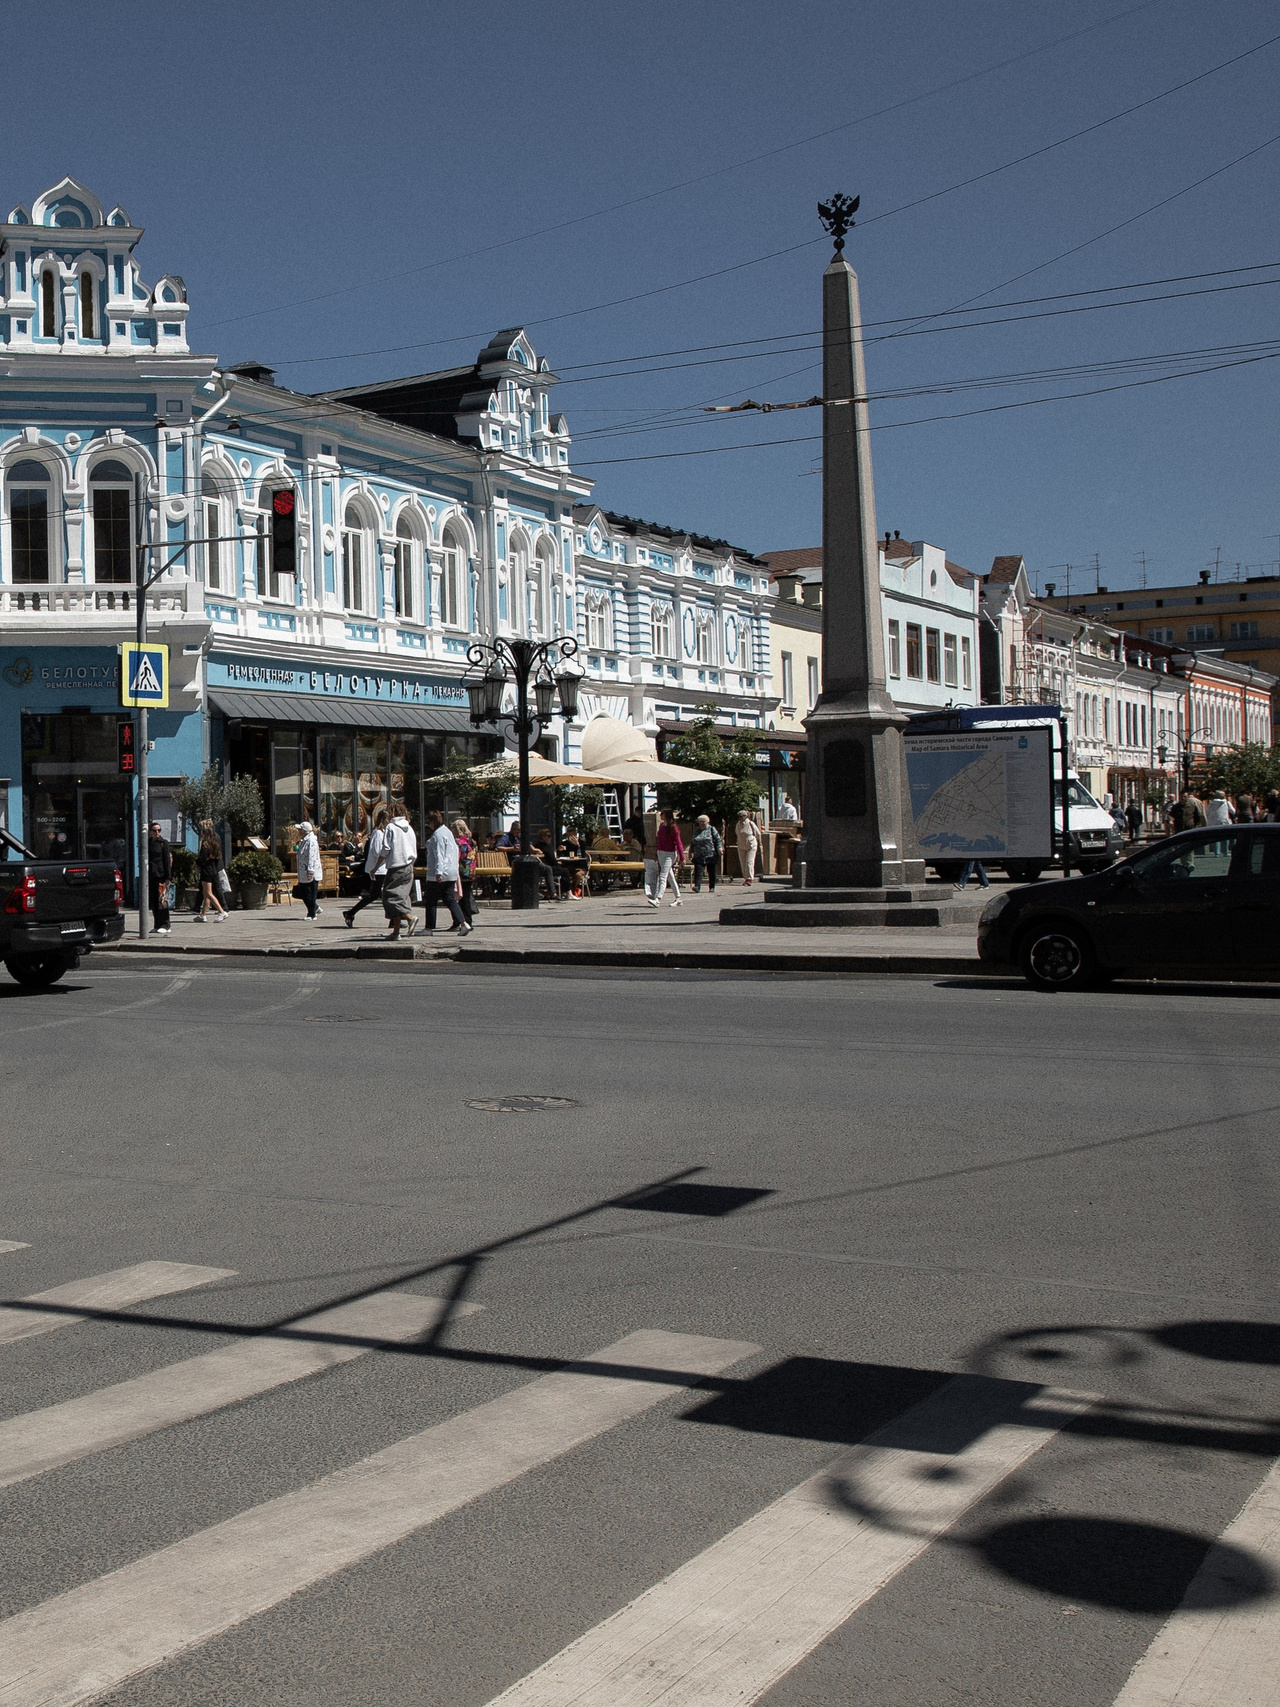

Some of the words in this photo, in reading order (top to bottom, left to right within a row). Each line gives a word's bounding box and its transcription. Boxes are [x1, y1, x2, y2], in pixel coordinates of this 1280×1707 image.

[41, 666, 118, 679] БЕЛОТУР
[46, 681, 103, 689] РЕМЕСЛЕННАЯ
[228, 664, 294, 682] РЕМЕСЛЕННАЯ
[309, 671, 421, 696] БЕЛОТУРКА
[432, 685, 466, 698] ПЕКАРНЯ
